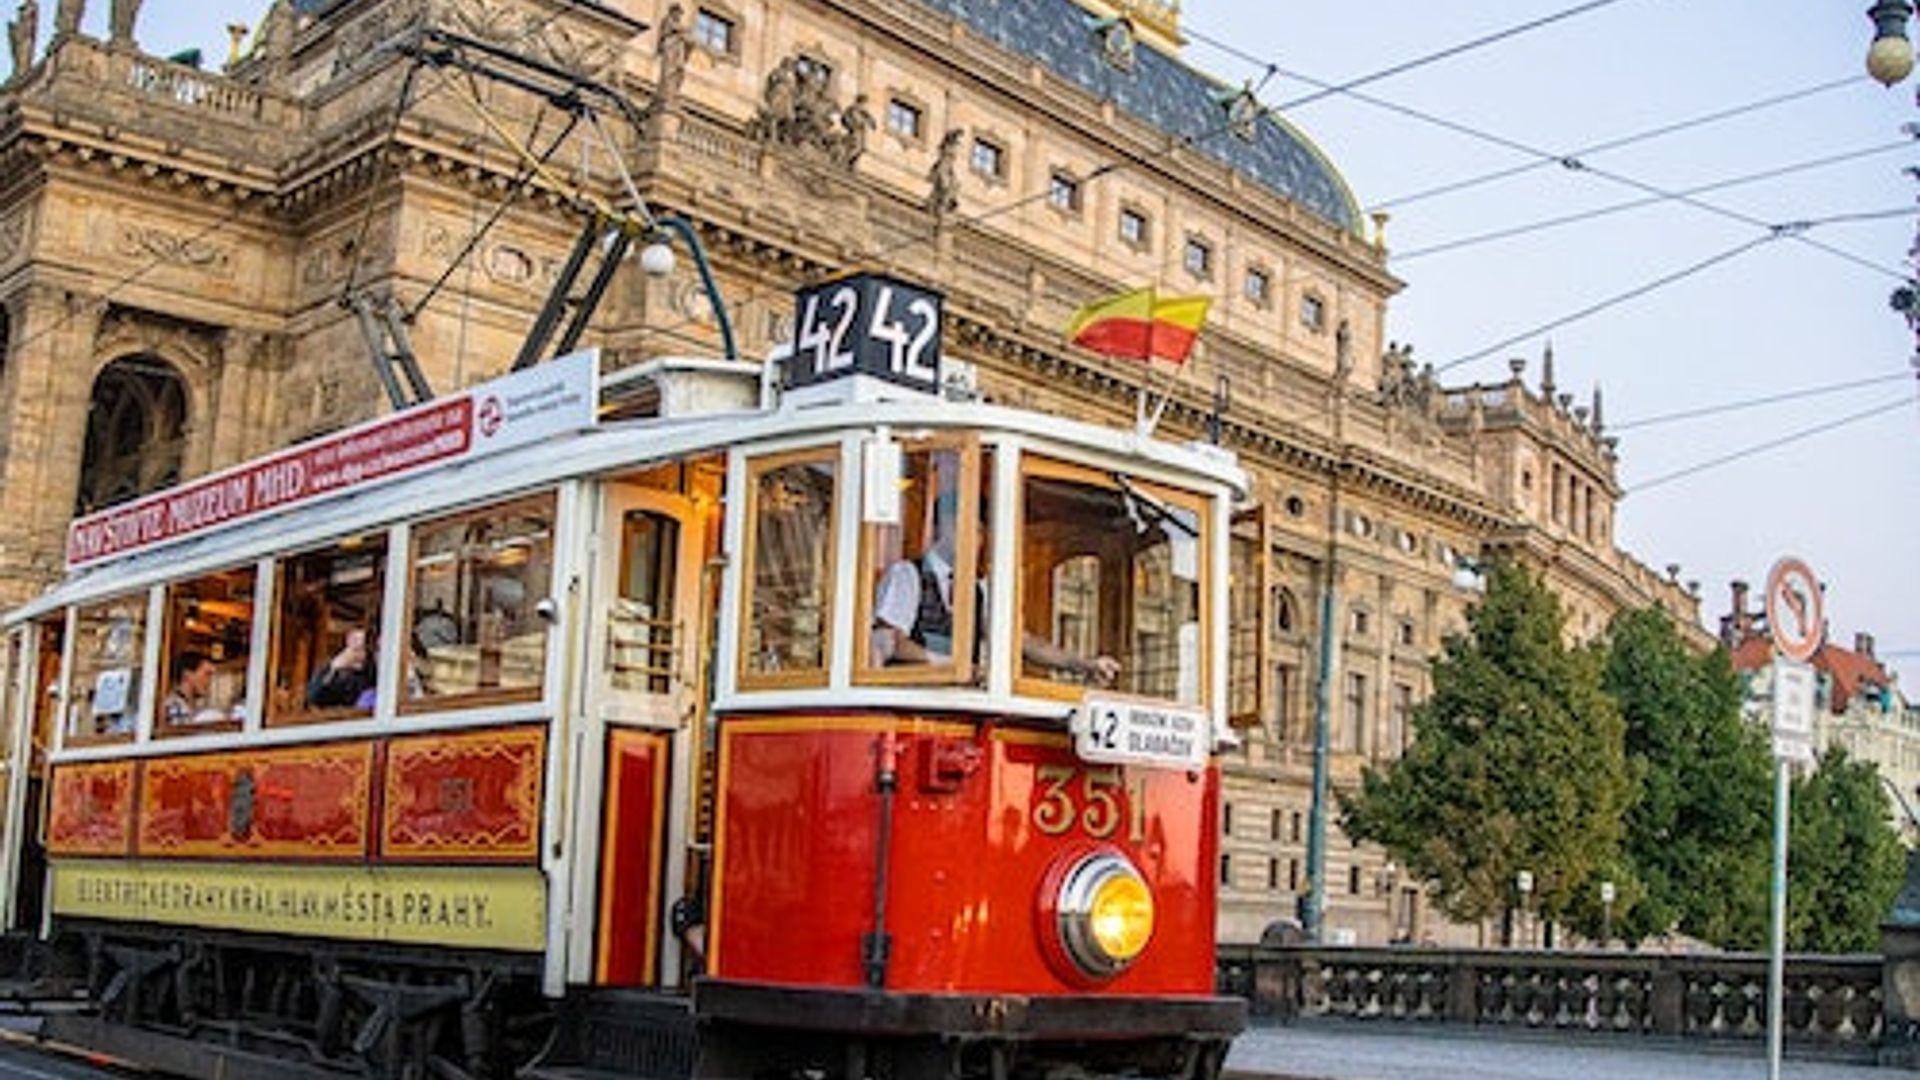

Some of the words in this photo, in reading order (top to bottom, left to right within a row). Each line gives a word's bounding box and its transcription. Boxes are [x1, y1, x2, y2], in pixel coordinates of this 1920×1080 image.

[800, 286, 857, 376] 42
[869, 286, 938, 383] 42
[167, 475, 249, 533] MUZEUM
[254, 459, 306, 508] MHD
[1089, 706, 1119, 750] 42
[1033, 765, 1146, 842] 351
[402, 890, 494, 929] PRAHY.
